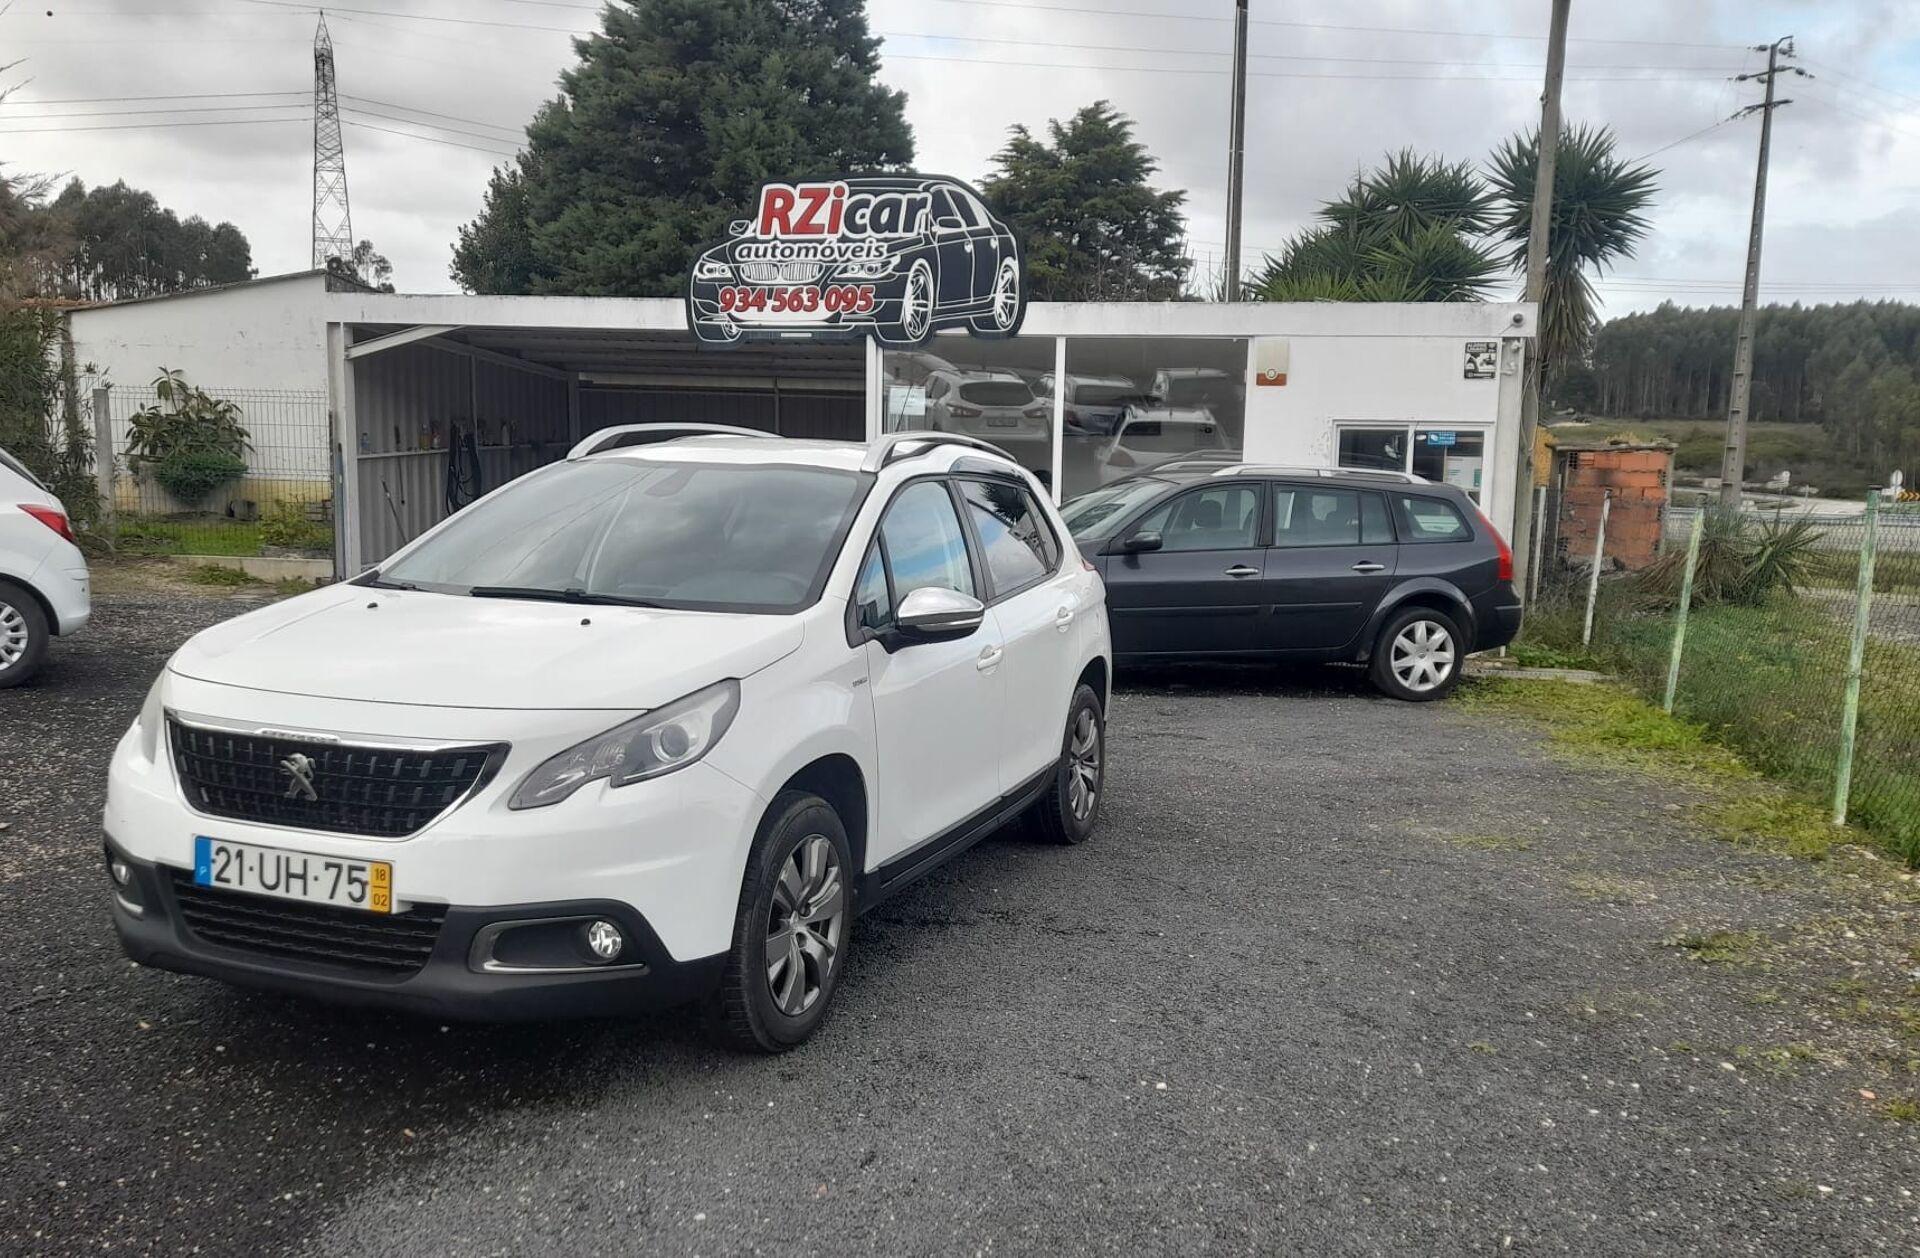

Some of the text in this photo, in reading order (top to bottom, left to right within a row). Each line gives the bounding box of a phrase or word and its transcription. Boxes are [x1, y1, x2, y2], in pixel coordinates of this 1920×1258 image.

[758, 184, 931, 237] RZicar
[738, 240, 886, 261] automóveis
[719, 286, 875, 313] 934 563 095
[374, 868, 387, 882] 18
[373, 893, 388, 907] 02
